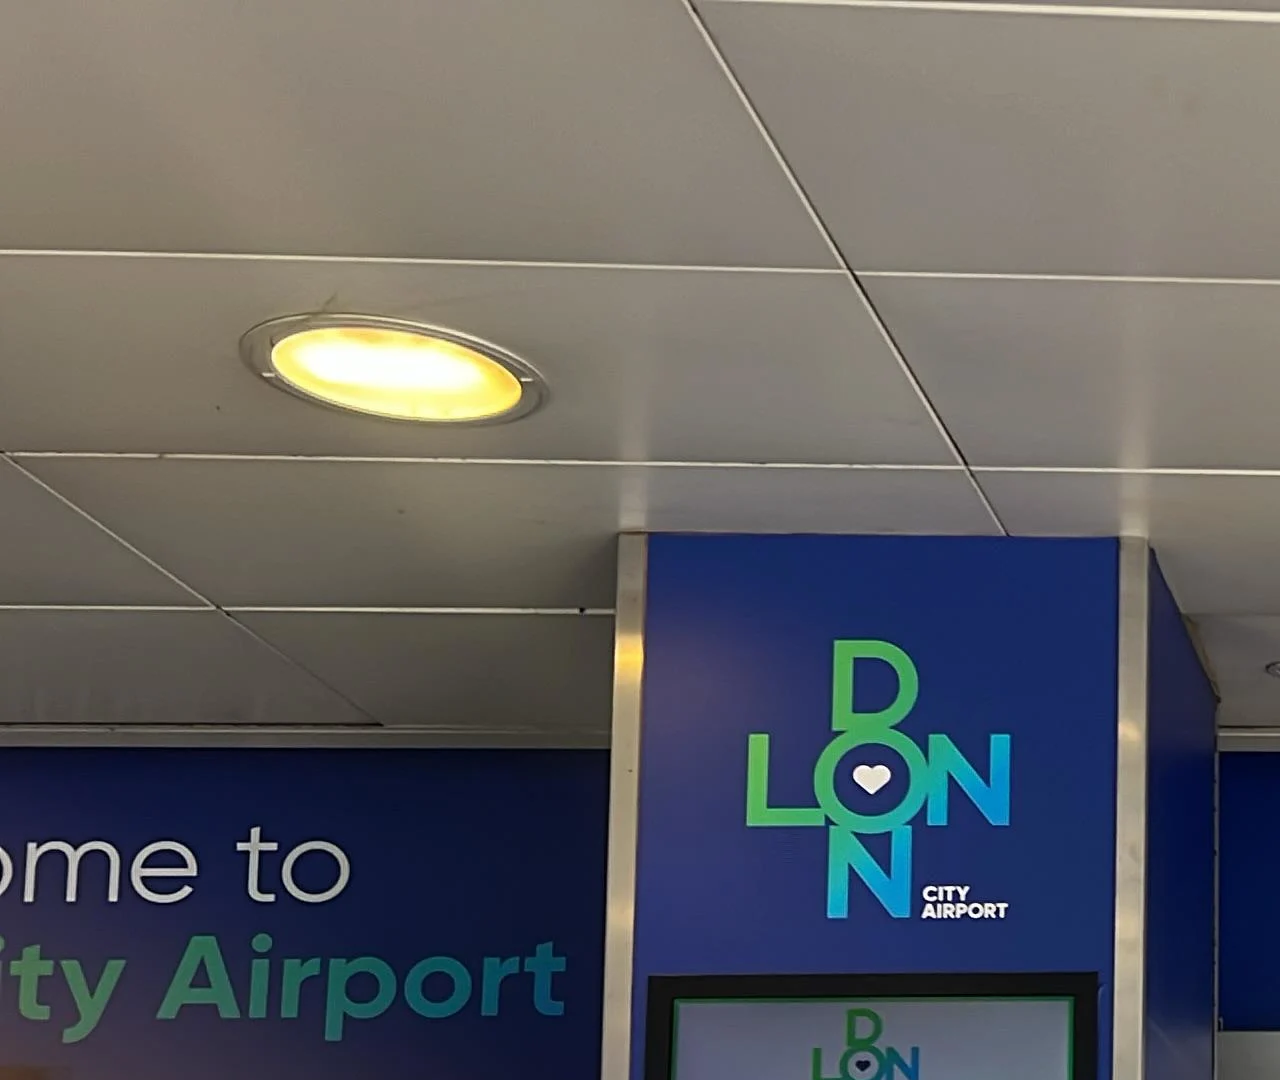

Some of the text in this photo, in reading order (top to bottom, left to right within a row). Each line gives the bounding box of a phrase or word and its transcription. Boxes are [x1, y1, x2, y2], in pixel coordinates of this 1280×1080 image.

[0, 826, 350, 904] me to
[921, 902, 1009, 919] AIRPORT
[922, 885, 970, 902] CITY
[0, 933, 566, 1043] ty Airport
